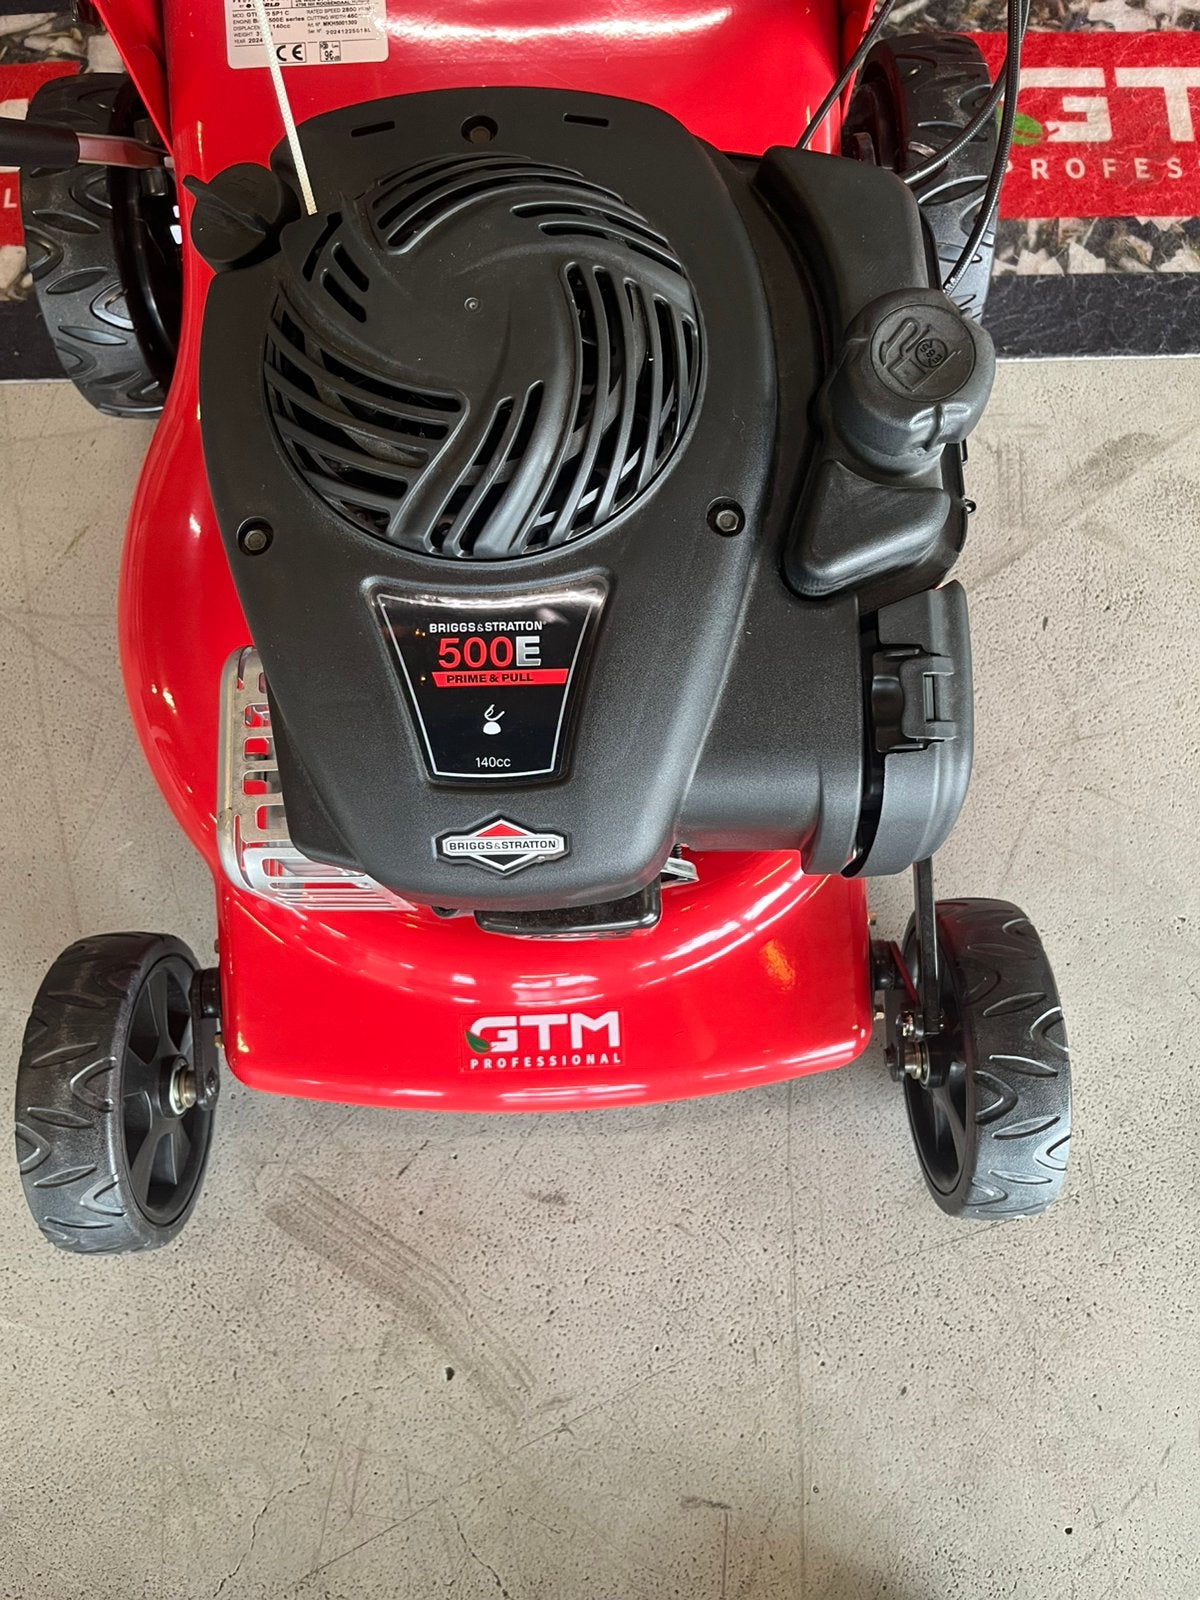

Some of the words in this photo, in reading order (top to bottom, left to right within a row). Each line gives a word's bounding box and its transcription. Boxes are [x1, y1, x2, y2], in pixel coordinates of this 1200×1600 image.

[1002, 156, 1200, 181] ROFES
[438, 635, 542, 669] 500E
[446, 674, 486, 684] PRIME
[488, 674, 498, 682] &
[502, 672, 534, 682] PULL
[475, 756, 512, 768] 140cc
[469, 1010, 620, 1052] GTM
[470, 1052, 621, 1070] PROFESSIONAL
